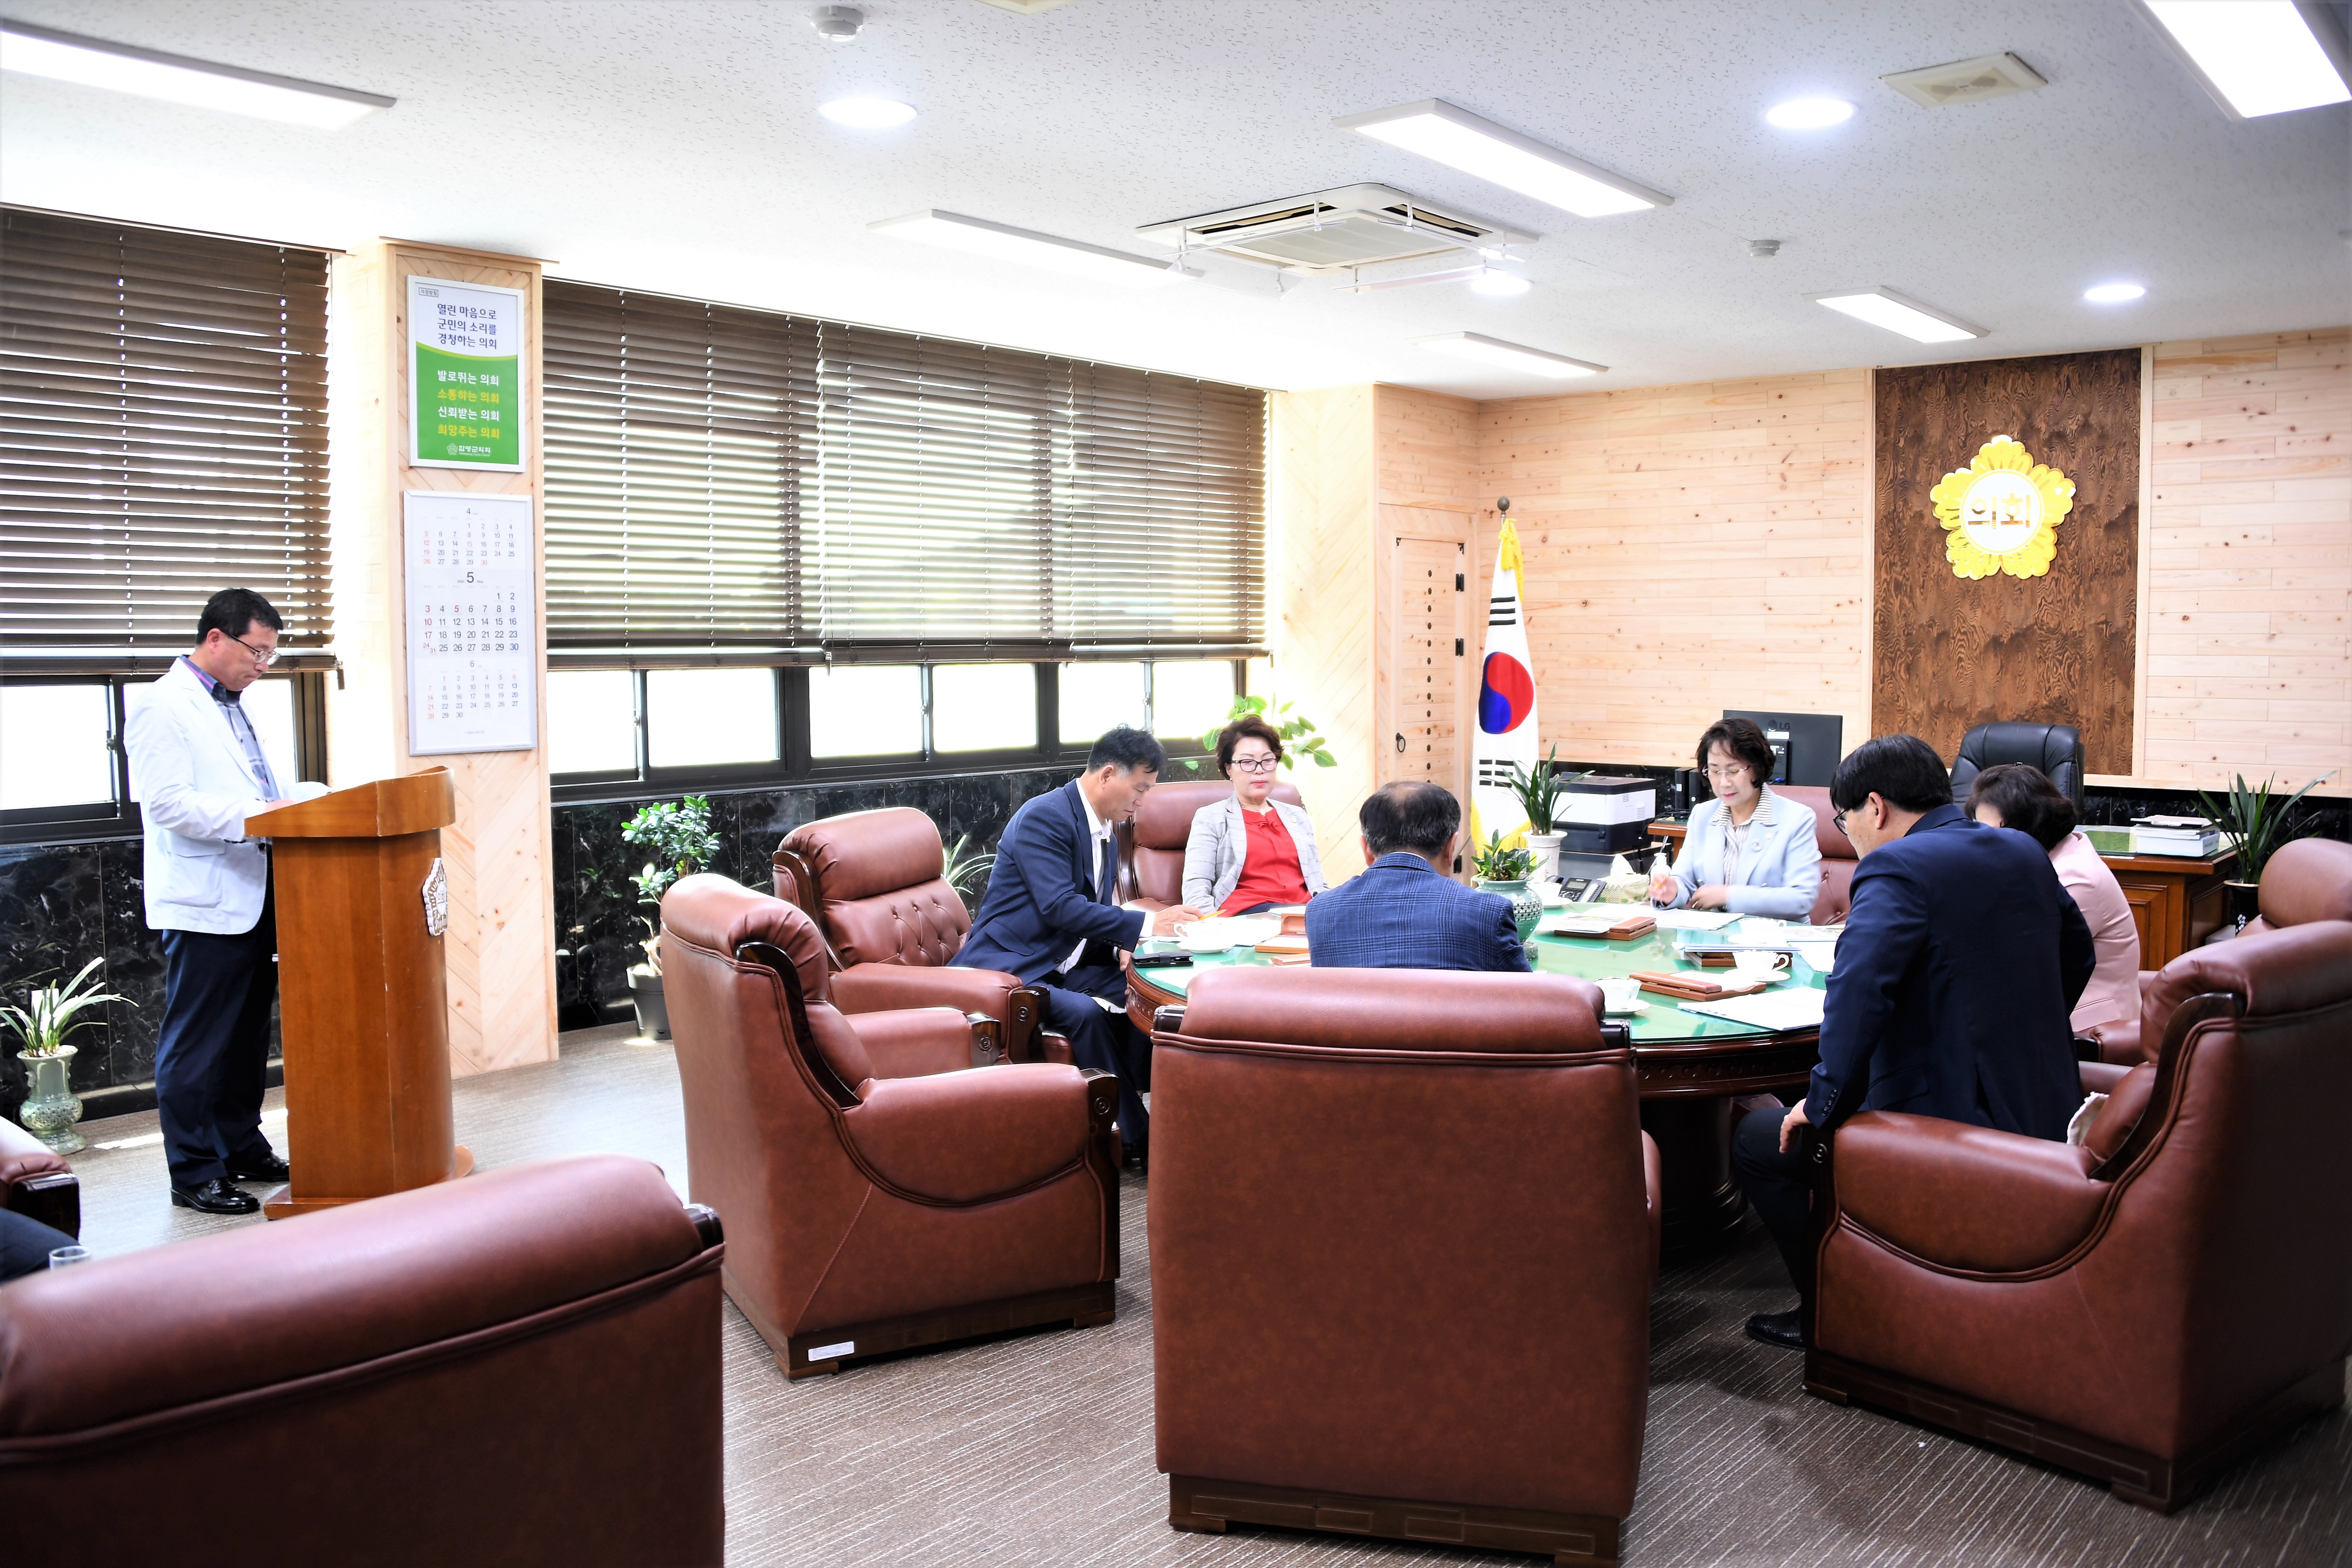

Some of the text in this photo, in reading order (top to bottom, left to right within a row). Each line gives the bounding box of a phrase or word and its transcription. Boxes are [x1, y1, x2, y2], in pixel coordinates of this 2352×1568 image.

[437, 303, 497, 320] 열린 마음으로
[438, 318, 497, 335] 군민의 소리를
[438, 333, 497, 349] 경청하는 의회
[437, 370, 499, 386] 발로뛰는 의회
[438, 389, 499, 403] 소통하는 의회
[438, 406, 500, 422] 신뢰받는 의회
[438, 424, 500, 439] 희망주는 의회
[1968, 493, 2031, 529] 의회
[466, 572, 474, 583] 5
